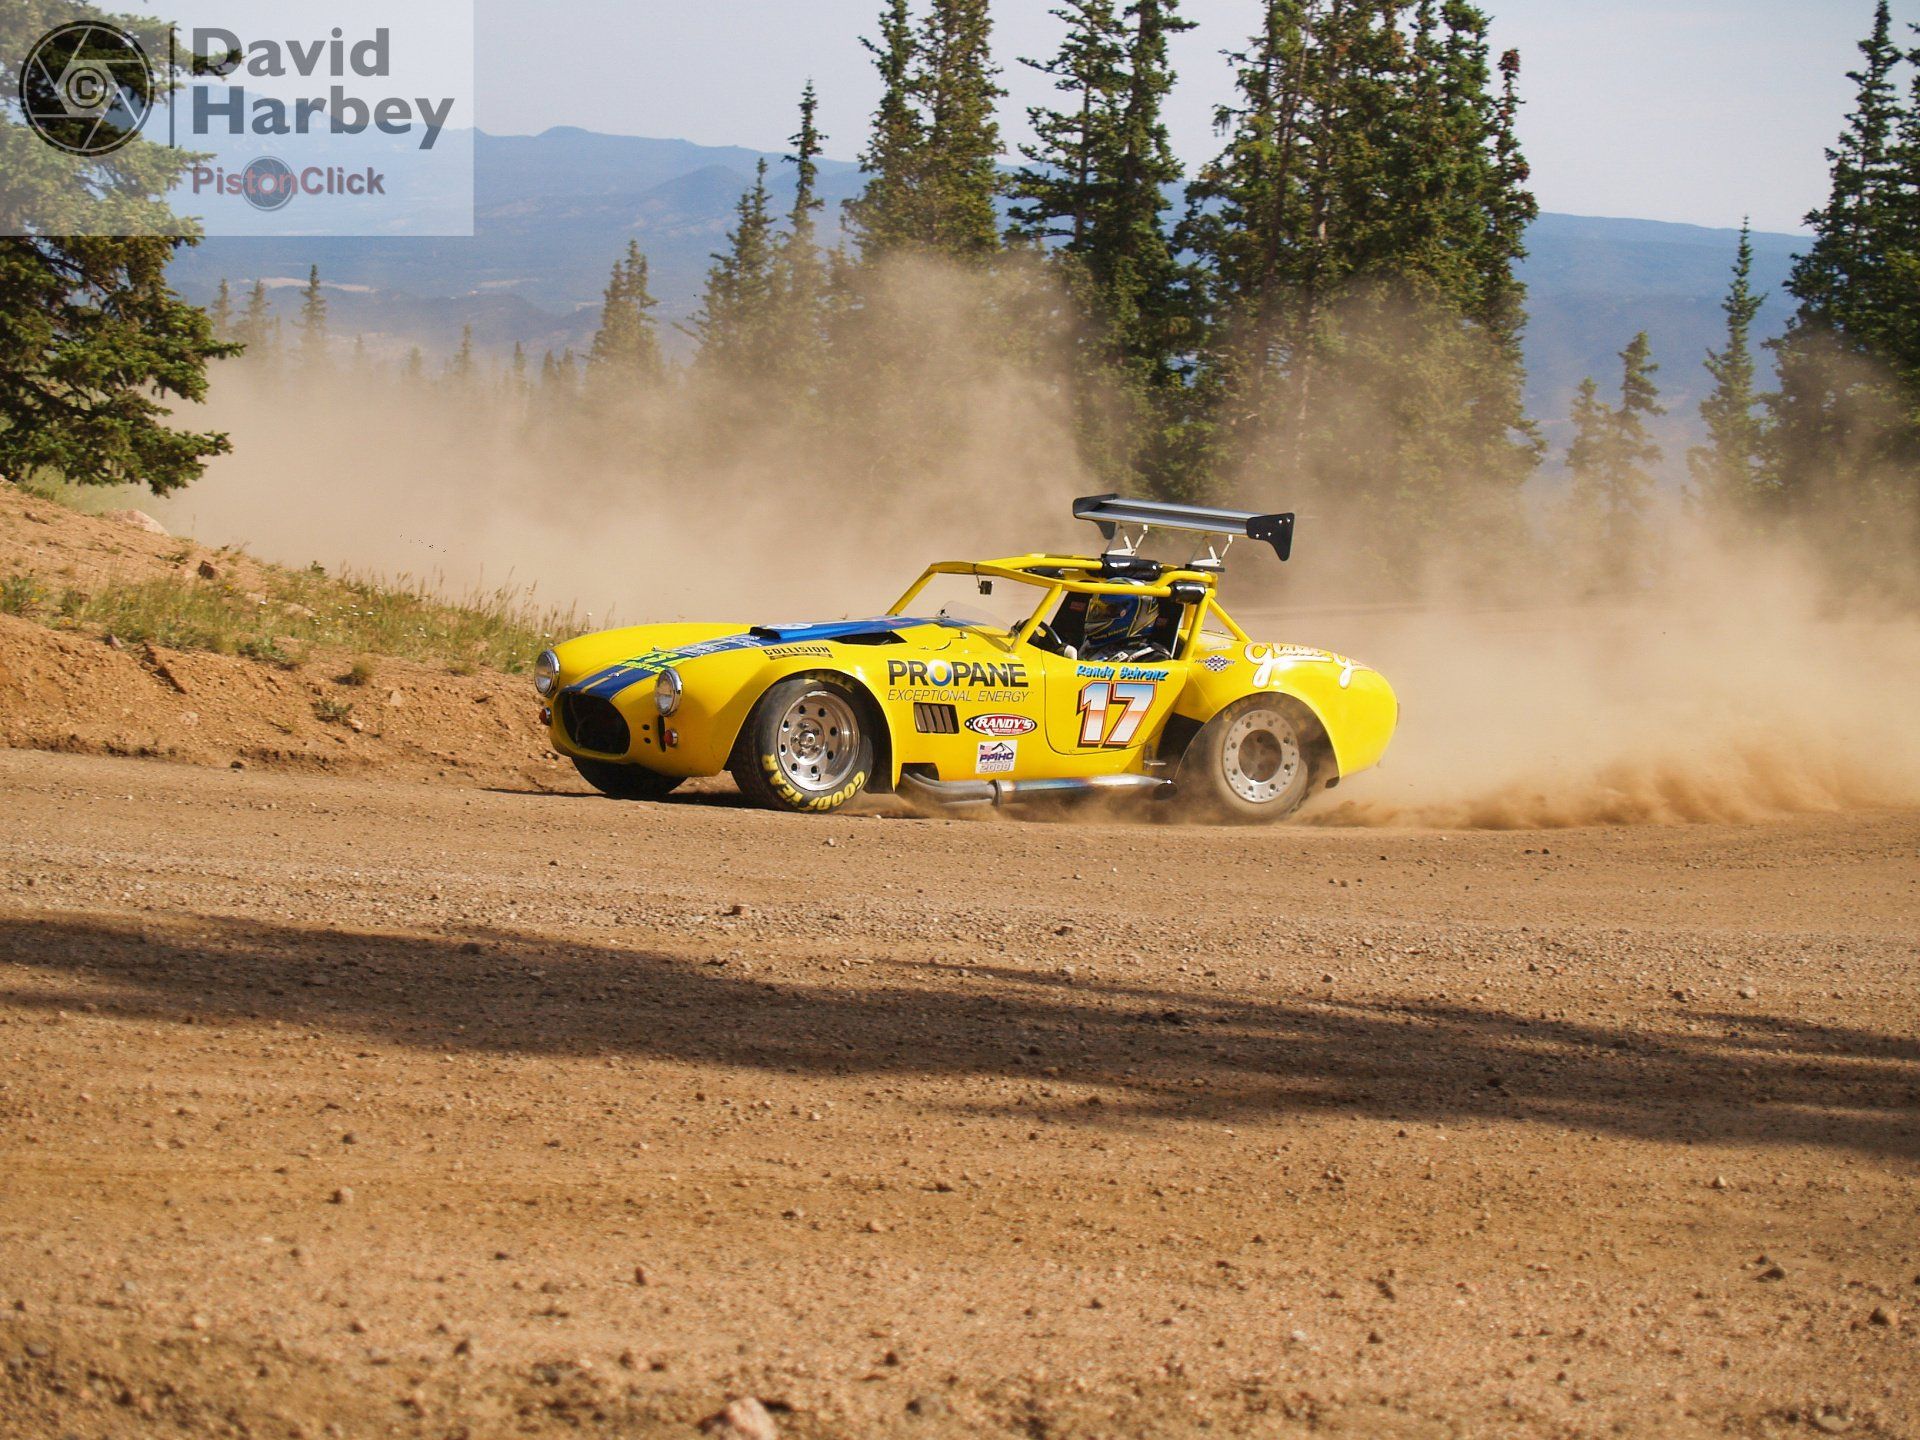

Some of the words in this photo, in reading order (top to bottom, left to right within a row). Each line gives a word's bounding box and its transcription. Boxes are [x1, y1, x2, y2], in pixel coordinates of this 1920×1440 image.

[762, 646, 831, 656] COLLISION
[887, 659, 1029, 688] PROPANE
[1076, 665, 1115, 680] Randy
[1120, 666, 1169, 681] Schranz
[887, 689, 972, 701] EXCEPTIONAL
[977, 690, 1031, 703] ENERGY
[1076, 680, 1157, 748] 17
[977, 717, 1033, 730] RANDY'S
